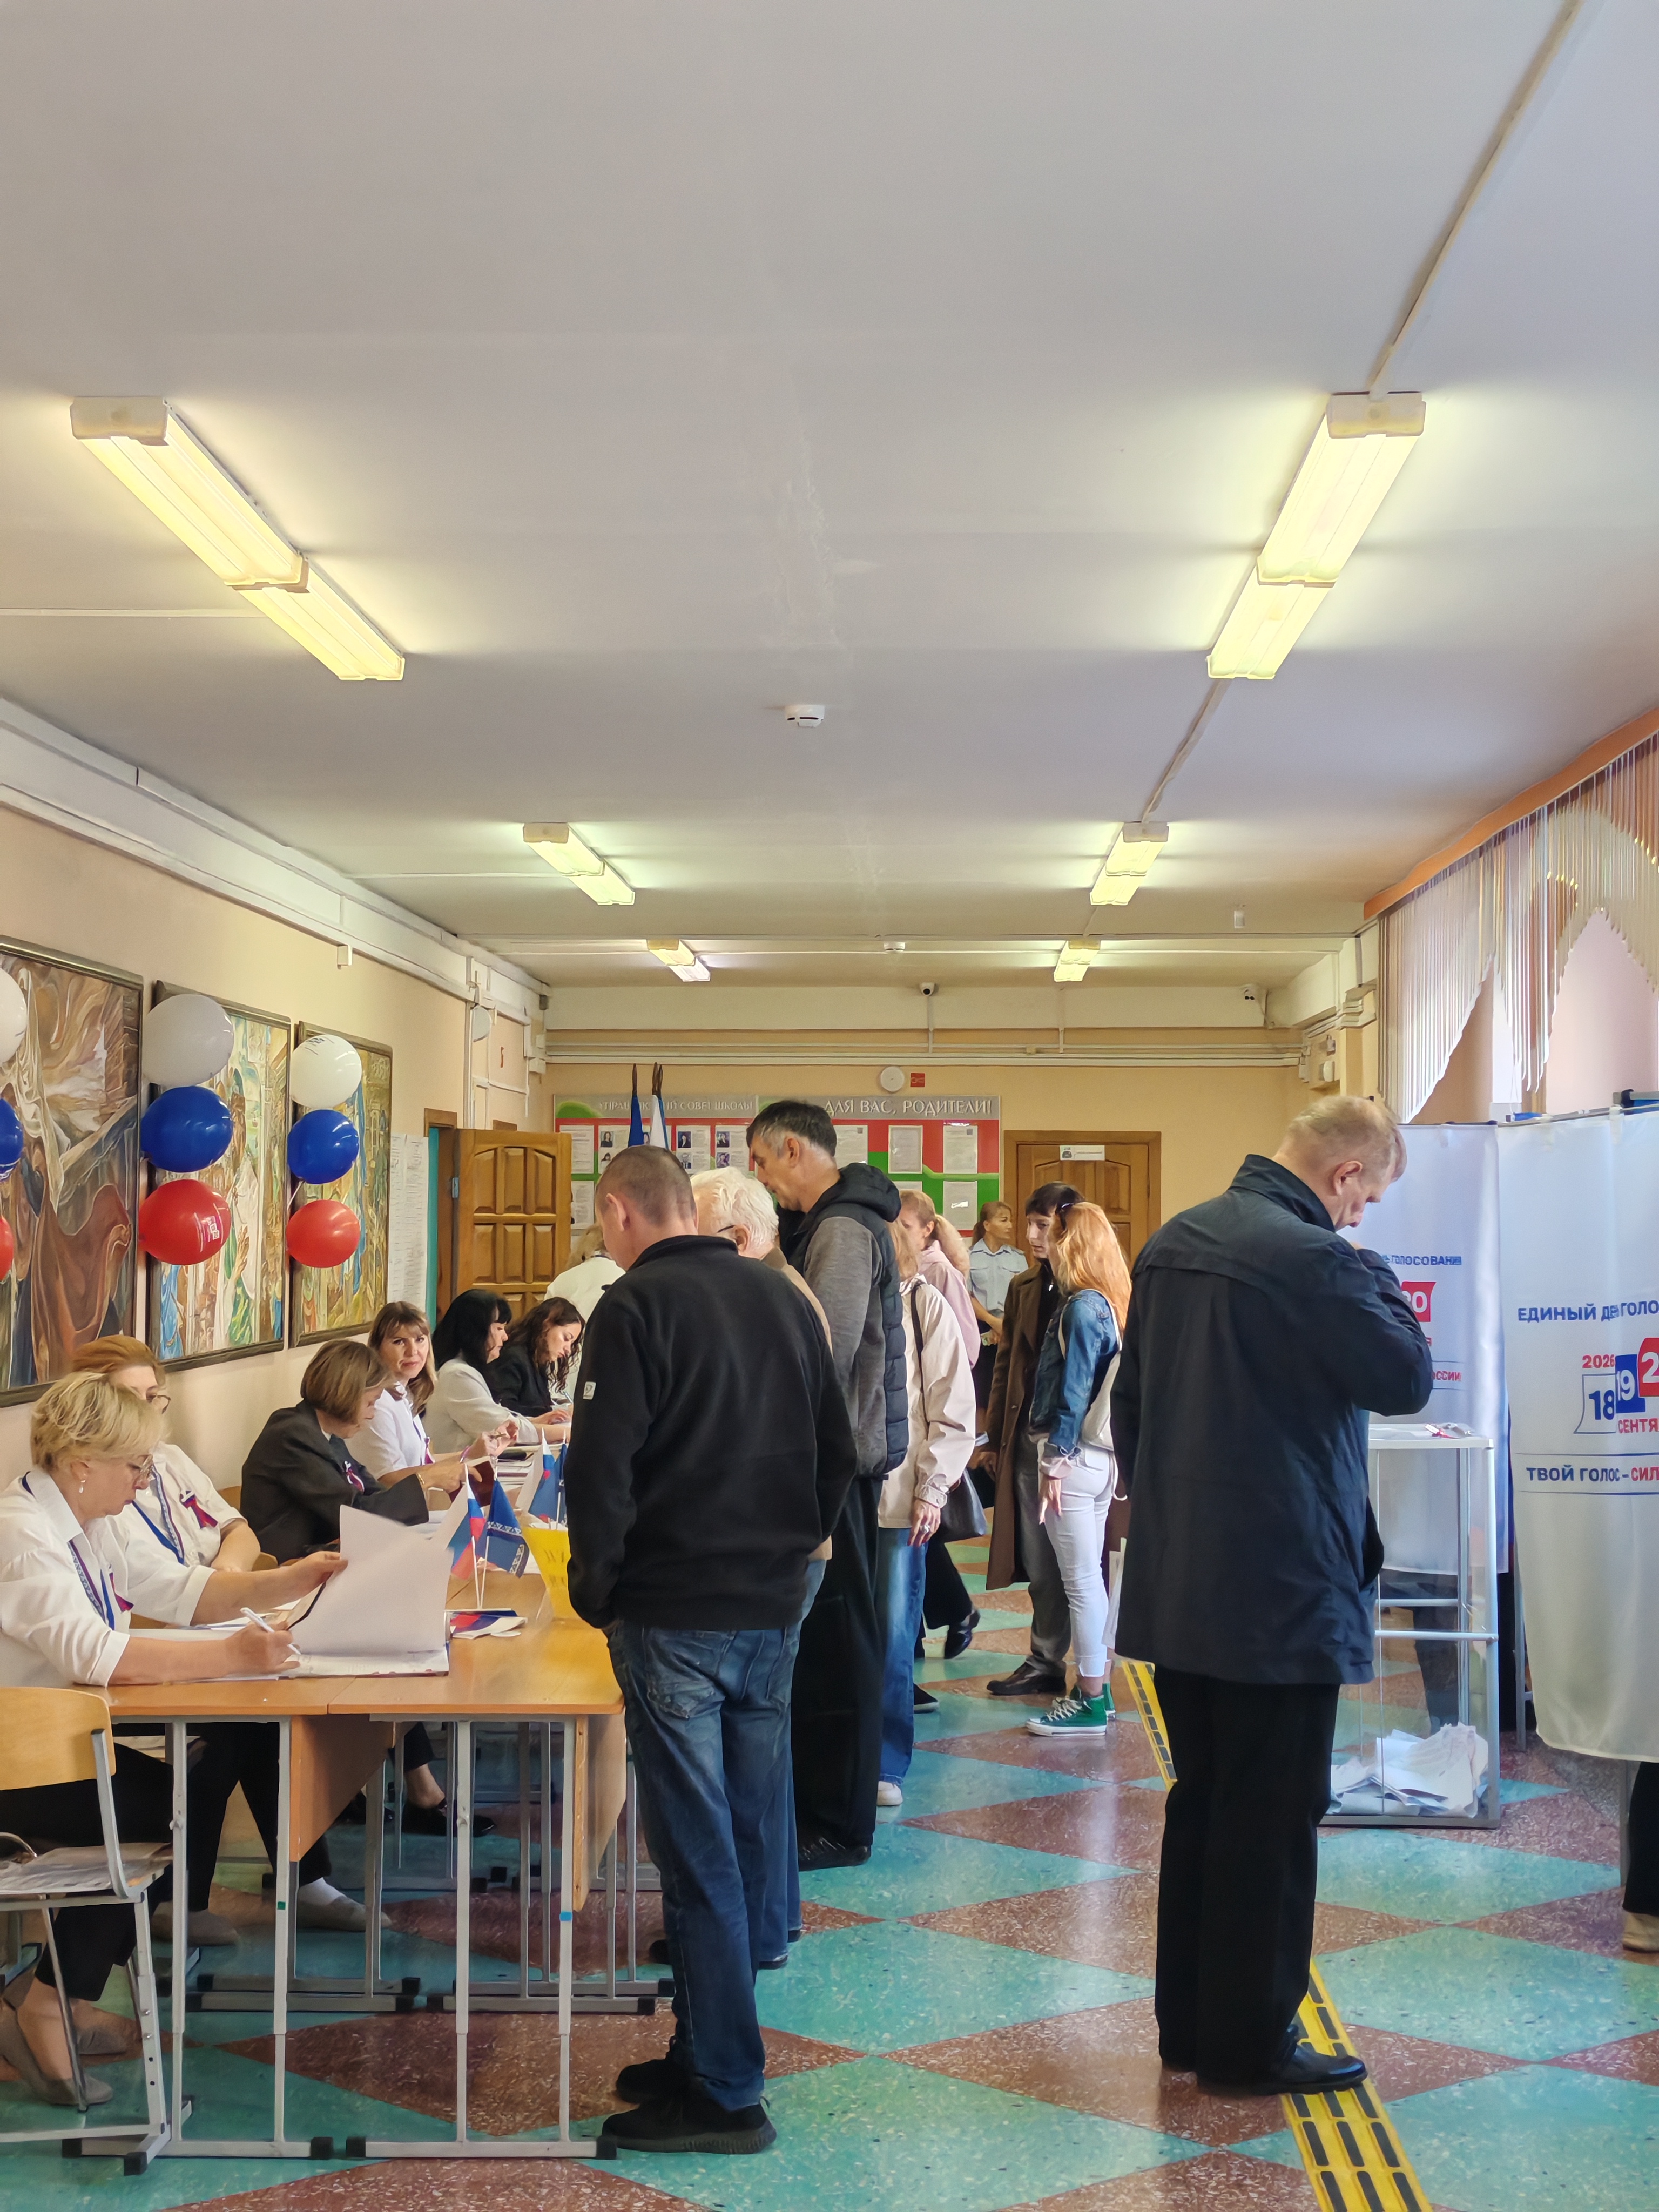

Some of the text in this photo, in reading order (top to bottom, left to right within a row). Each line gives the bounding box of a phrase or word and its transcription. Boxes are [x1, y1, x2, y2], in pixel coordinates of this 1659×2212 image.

[680, 1101, 711, 1110] СОВЕТ
[715, 1101, 753, 1110] ШКОЛЫ
[825, 1099, 992, 1117] ДЛЯ ВАС, РОДИТЕЛИ!
[1518, 1303, 1596, 1323] ЕДИНЫЙ
[1582, 1354, 1615, 1368] 2026
[1589, 1390, 1615, 1420] 18
[1526, 1464, 1574, 1481] ТВОЙ
